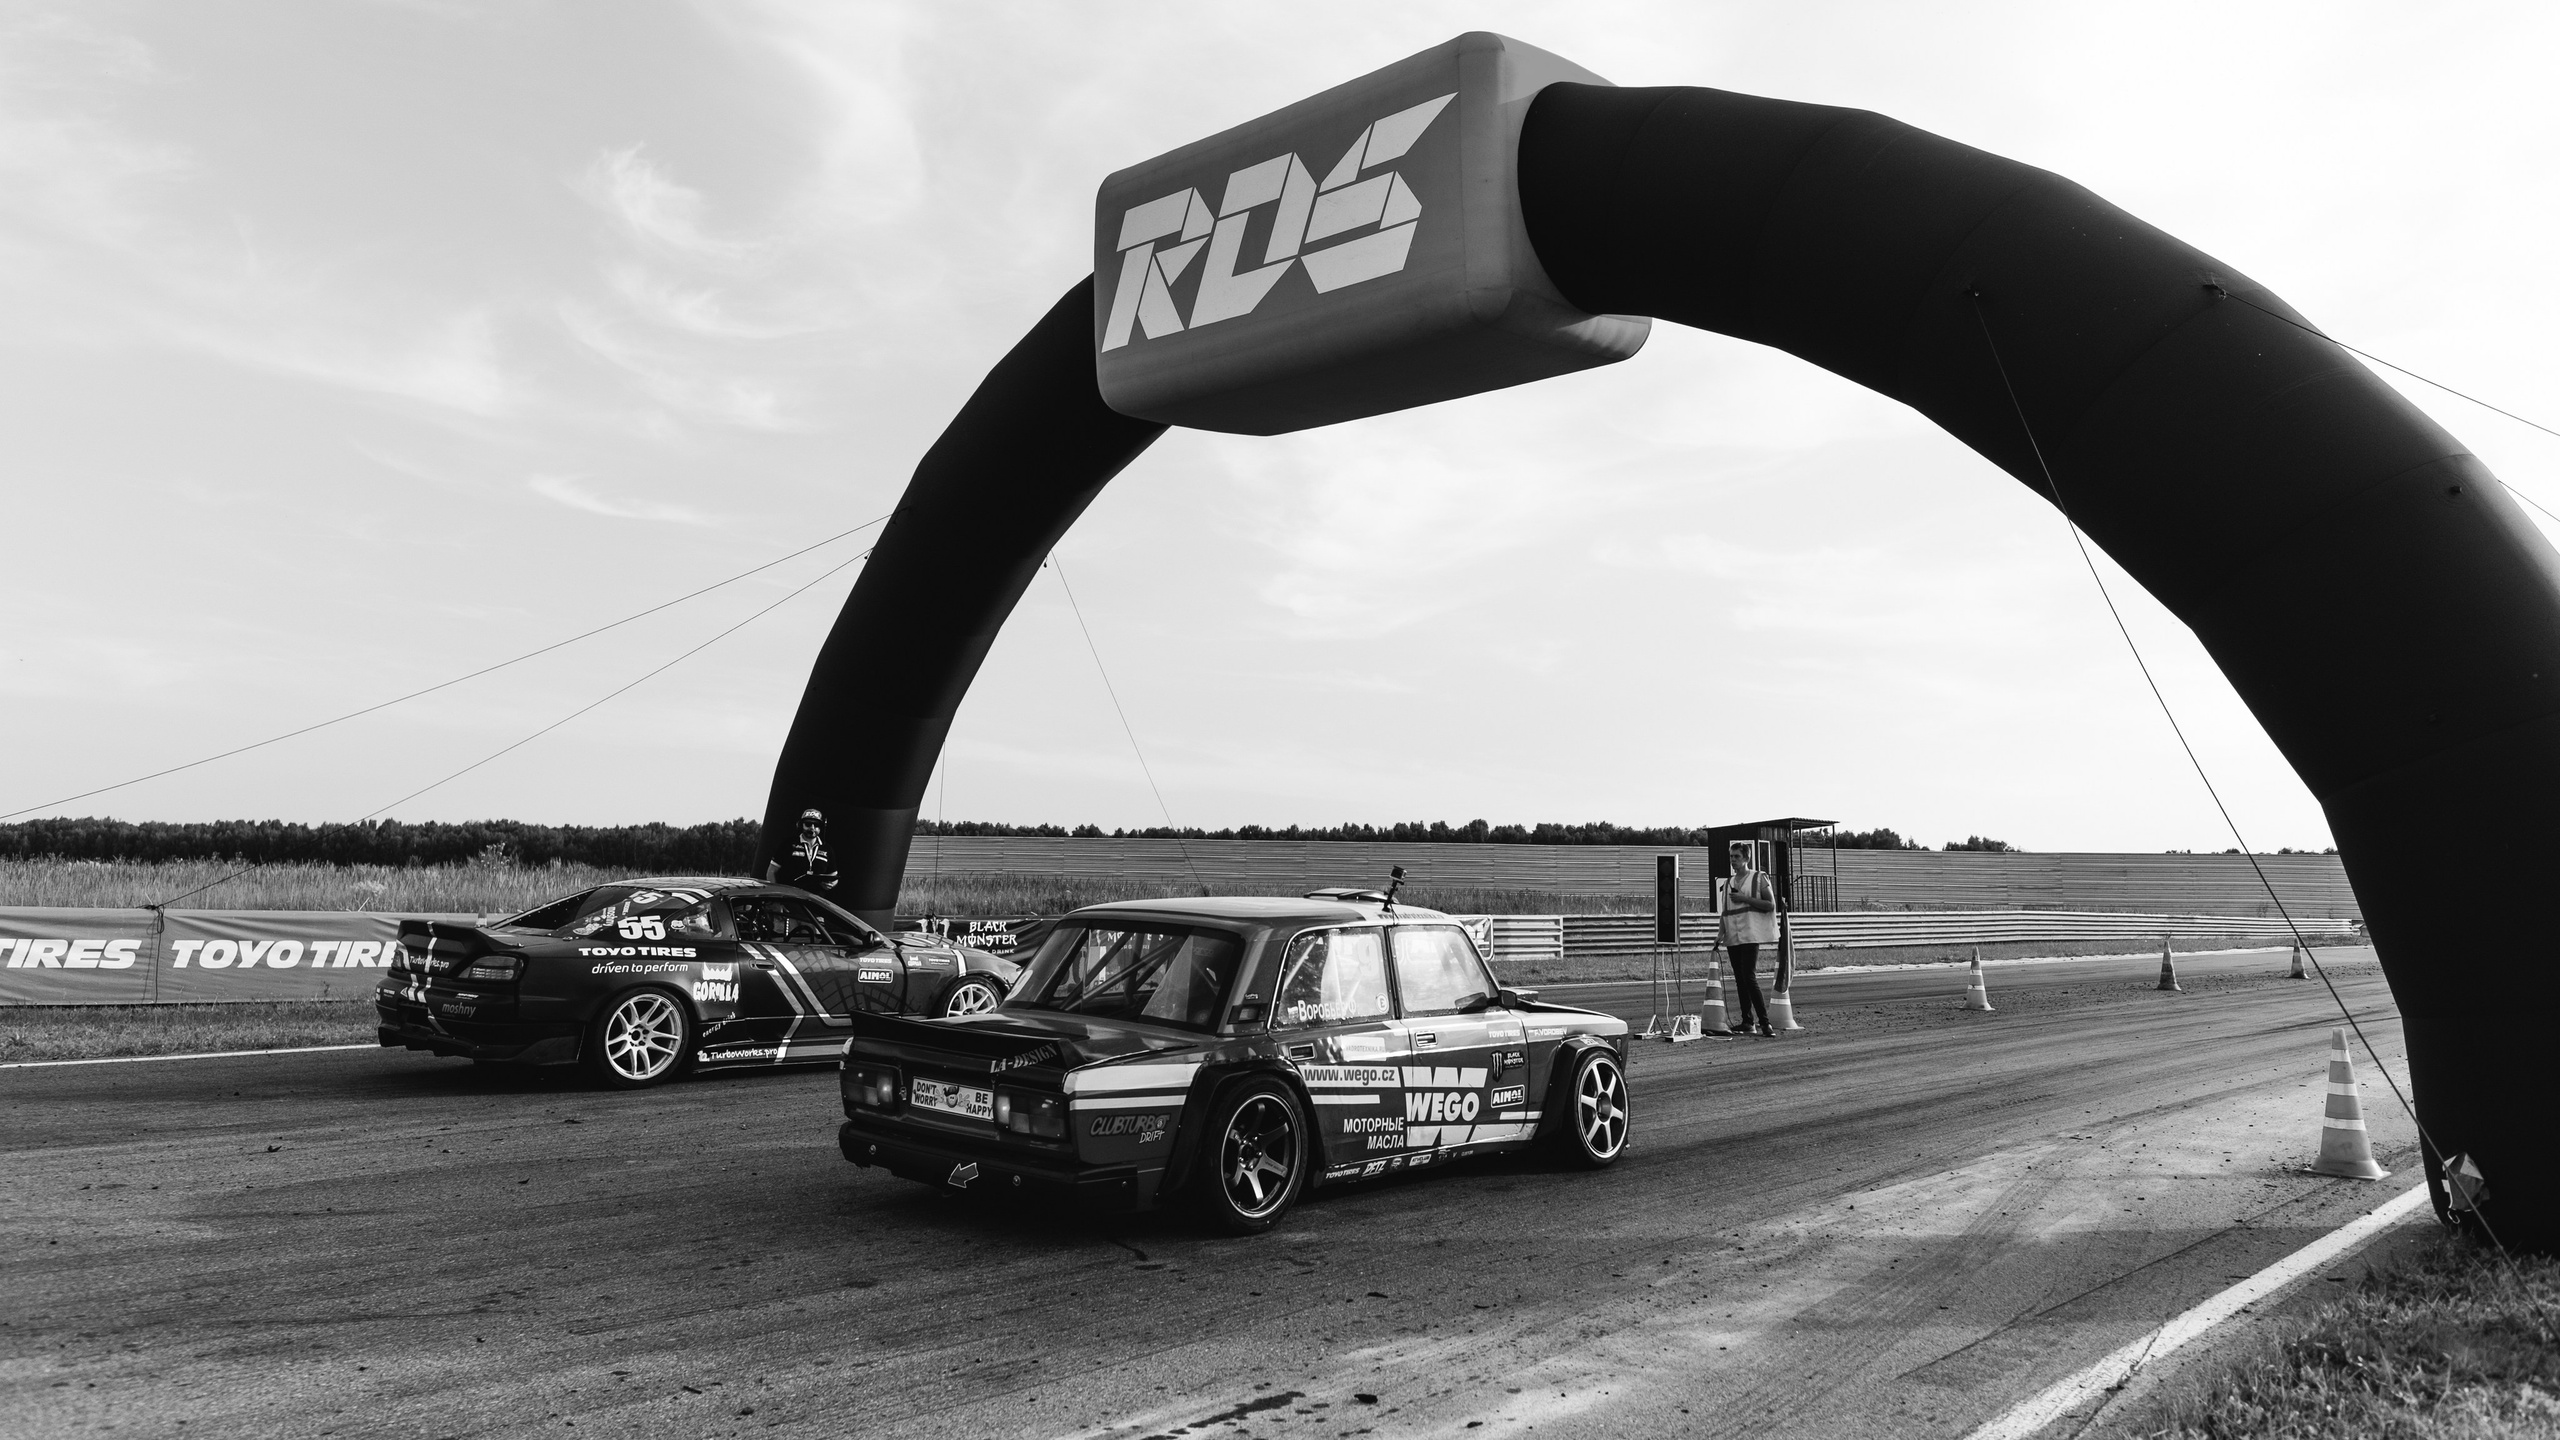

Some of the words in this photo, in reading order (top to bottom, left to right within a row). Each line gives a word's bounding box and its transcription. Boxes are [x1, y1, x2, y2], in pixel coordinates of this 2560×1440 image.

[1102, 91, 1458, 353] RDS
[617, 915, 667, 940] 55
[969, 921, 1007, 933] BLACK
[171, 939, 305, 969] TOYO
[579, 947, 636, 957] TOYO
[638, 947, 697, 958] TIRES
[592, 961, 628, 974] driven
[631, 963, 643, 973] to
[644, 961, 689, 975] perform
[693, 981, 739, 1003] GORILLA
[442, 1002, 476, 1018] moshny
[990, 1043, 1058, 1073] LA-DESIGN
[1304, 1069, 1395, 1085] www.wego.cz
[916, 1081, 937, 1095] DON'T
[975, 1092, 988, 1105] BE
[913, 1092, 938, 1107] WORRY
[966, 1103, 993, 1117] HAPPY
[1405, 1092, 1480, 1122] WEGO
[1343, 1116, 1404, 1133] МОТОРНЫЕ
[1139, 1130, 1166, 1144] DRIFT
[1367, 1134, 1404, 1150] МАСЛА
